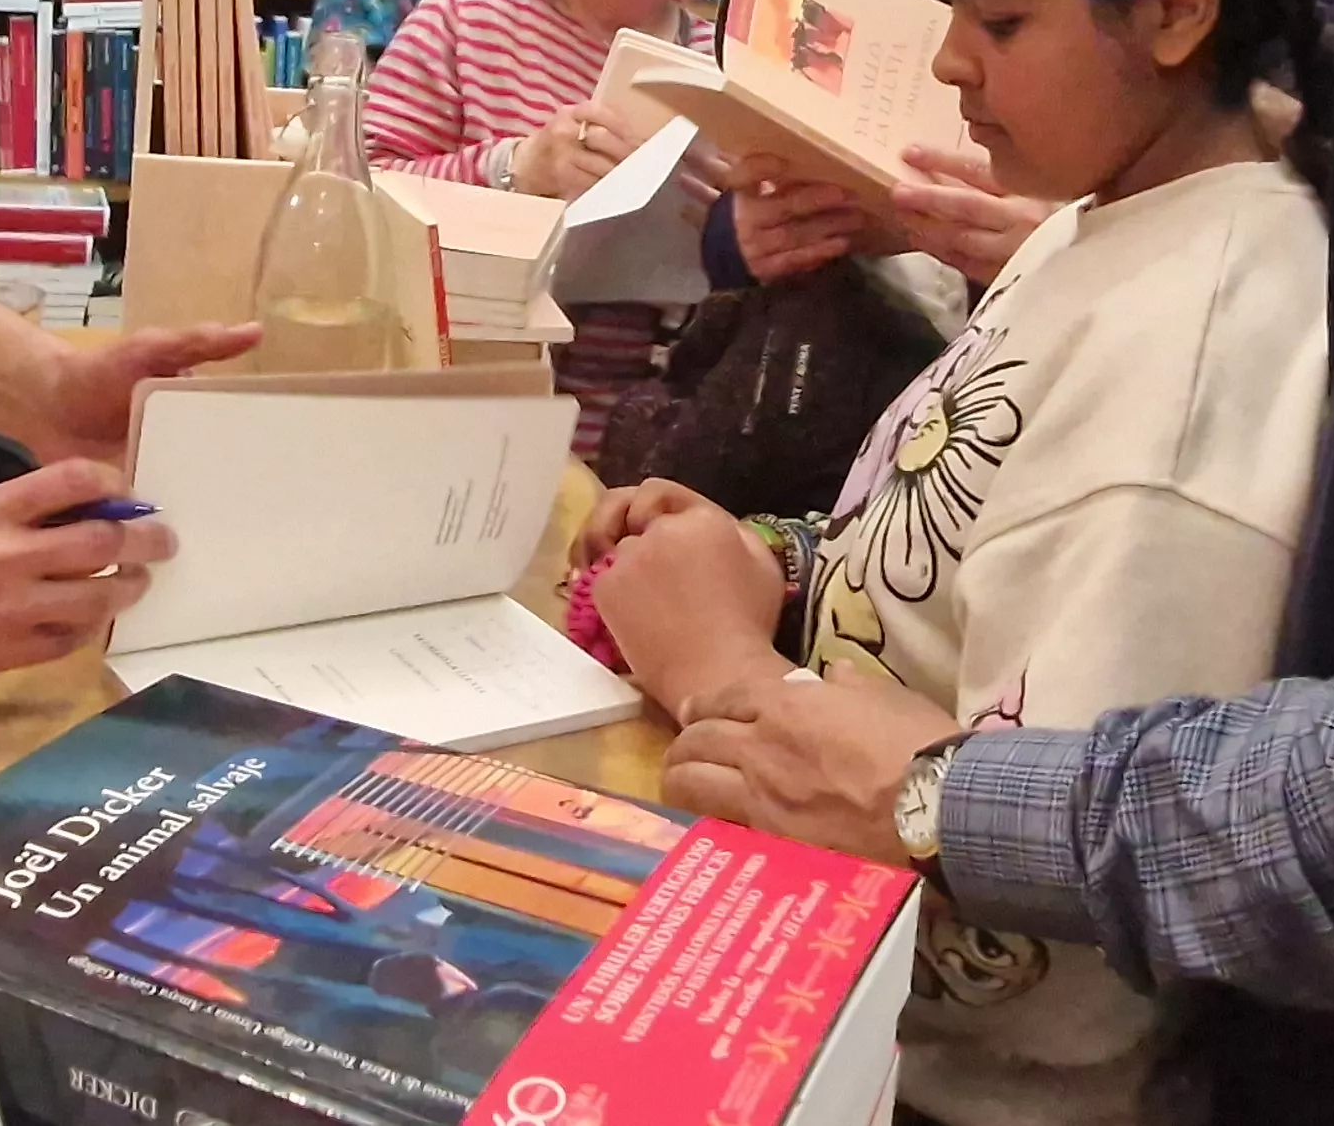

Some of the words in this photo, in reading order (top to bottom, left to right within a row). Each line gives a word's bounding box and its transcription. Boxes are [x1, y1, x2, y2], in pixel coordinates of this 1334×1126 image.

[36, 878, 105, 920] Un
[98, 810, 192, 885] animal
[185, 752, 267, 815] salvaje
[47, 766, 176, 848] Dicker
[560, 993, 595, 1024] UN
[581, 923, 651, 997] THRILLER
[636, 835, 715, 924] VERTIGINOSO
[592, 968, 643, 1025] SOBRE
[630, 902, 694, 973] PASIONES
[681, 847, 734, 906] FEROCES
[69, 1070, 158, 1118] DICKER
